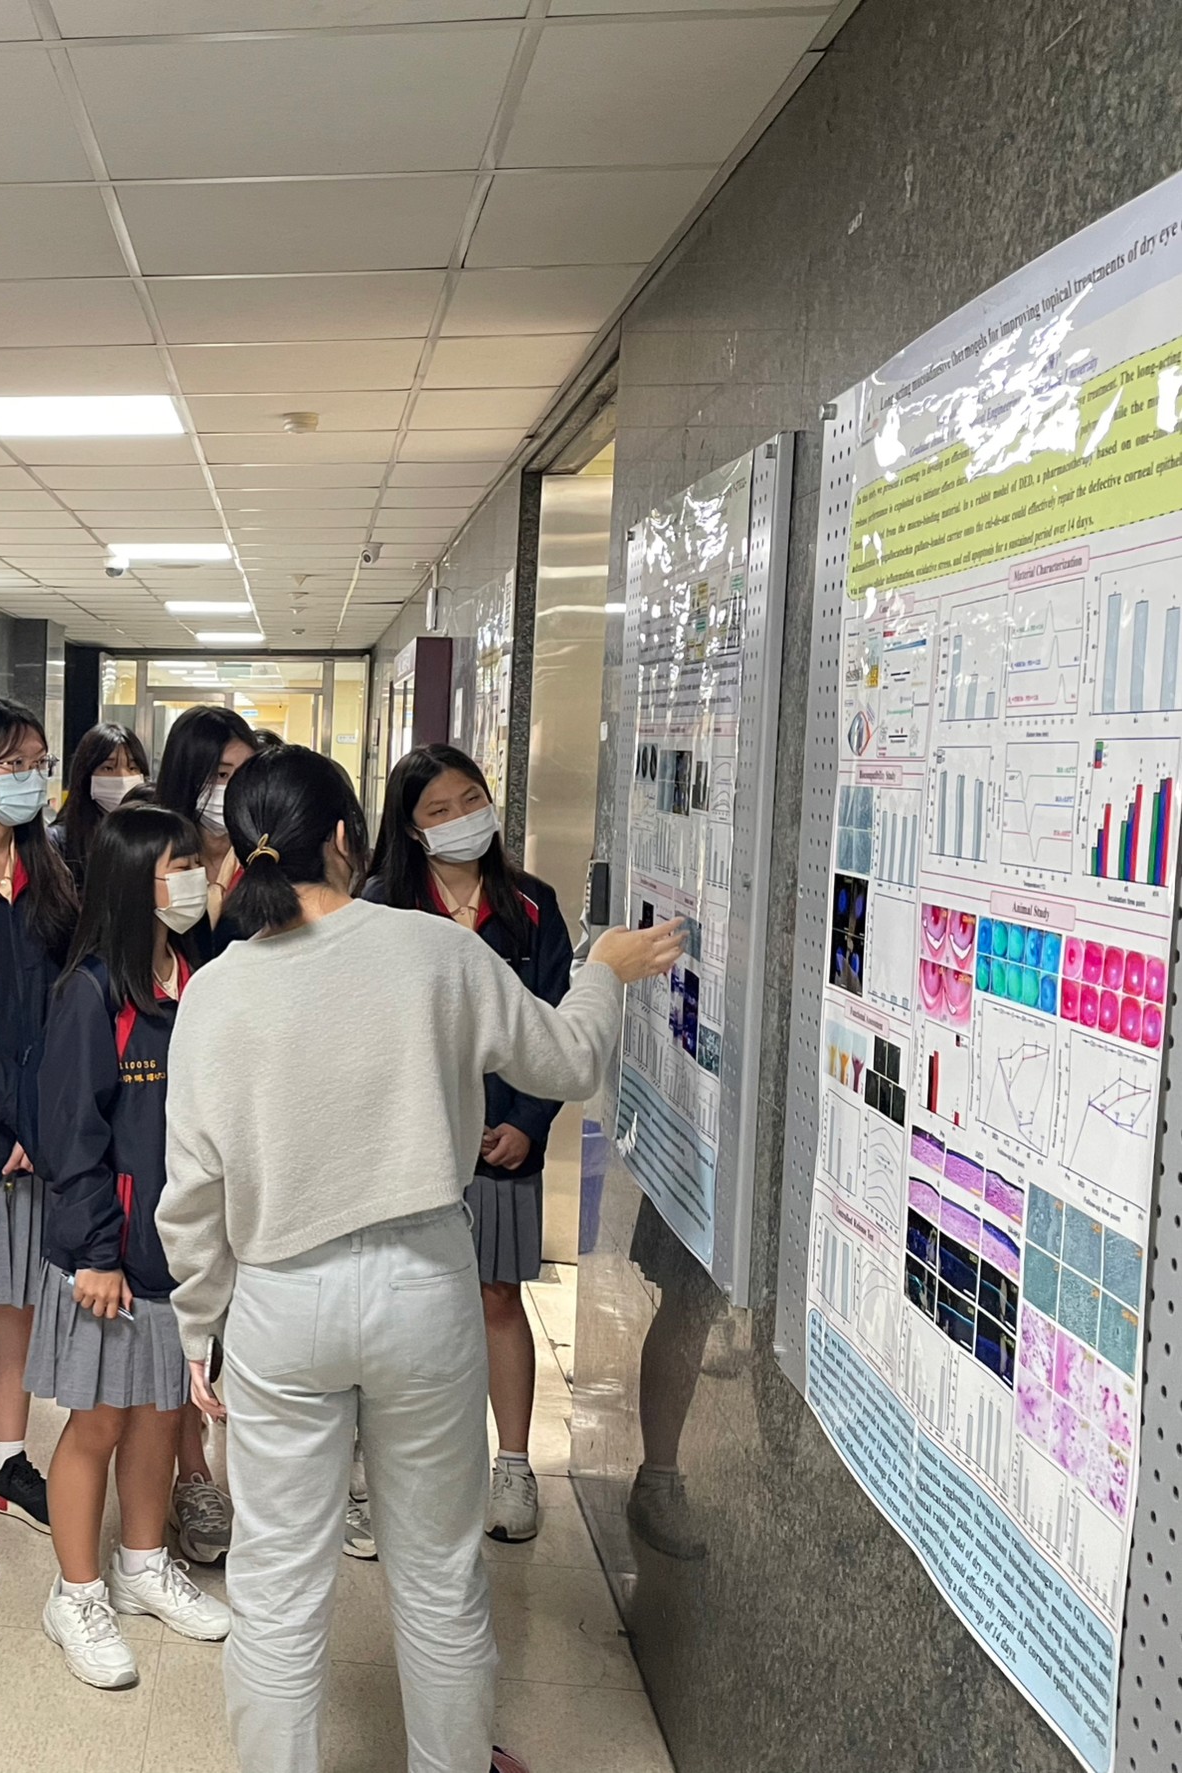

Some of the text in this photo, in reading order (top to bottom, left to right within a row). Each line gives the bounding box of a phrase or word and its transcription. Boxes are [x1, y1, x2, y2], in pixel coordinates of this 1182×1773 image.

[950, 333, 987, 367] thermogels
[988, 328, 998, 343] for
[1000, 301, 1041, 337] improving
[1042, 280, 1072, 313] topical
[1074, 254, 1125, 294] treatments
[1128, 240, 1139, 263] of
[1140, 234, 1157, 256] dry
[1159, 221, 1178, 246] eye
[1121, 371, 1134, 385] The
[1137, 352, 1181, 378] long-acting
[1131, 401, 1144, 414] the
[976, 492, 990, 505] rabbit
[993, 483, 1009, 499] model
[1011, 480, 1017, 492] of
[1019, 474, 1034, 490] DED,
[1097, 440, 1117, 459] based
[1121, 440, 1131, 451] on
[1012, 505, 1026, 520] could
[1028, 496, 1056, 515] effectively
[1057, 488, 1075, 507] repair
[1076, 484, 1086, 498] the
[1088, 475, 1121, 494] defective
[1124, 461, 1154, 483] corneal
[995, 542, 1003, 553] for
[1034, 525, 1052, 545] period
[1054, 524, 1066, 536] over
[1068, 518, 1074, 532] 14
[1076, 516, 1094, 530] days.
[1014, 556, 1082, 580] Material Characterization
[1012, 901, 1050, 922] Animal Study
[956, 1516, 973, 1541] gallate
[975, 1536, 1001, 1571] molecules
[1003, 1567, 1013, 1586] and
[1015, 1581, 1034, 1610] elevate
[1036, 1607, 1044, 1624] the
[1047, 1620, 1062, 1648] drug
[976, 1495, 993, 1524] Owing
[995, 1516, 1000, 1528] to
[1001, 1523, 1009, 1539] the
[1011, 1535, 1031, 1566] rational
[1033, 1561, 1053, 1593] design
[1055, 1584, 1061, 1600] of
[1063, 1593, 1071, 1611] the
[1074, 1606, 1084, 1625] GN
[1087, 1621, 1112, 1659] through
[949, 1530, 963, 1552] model
[965, 1546, 972, 1561] of
[972, 1554, 981, 1576] dry
[983, 1569, 993, 1589] eye
[995, 1580, 1016, 1613] disease,
[1024, 1614, 1074, 1686] pharmacological
[1075, 1678, 1108, 1724] treatment
[957, 1584, 984, 1629] follow-up
[984, 1615, 992, 1634] of
[992, 1624, 1001, 1645] 14
[1000, 1634, 1016, 1666] days.
[966, 1571, 994, 1614] effectively
[996, 1607, 1015, 1640] repair
[1016, 1627, 1027, 1649] the
[1028, 1640, 1052, 1679] corneal
[1053, 1672, 1082, 1718] epithelial
[1008, 1552, 1049, 1609] biodegradable,
[1051, 1603, 1096, 1664] mucoadhesive,
[1099, 1660, 1111, 1680] and
